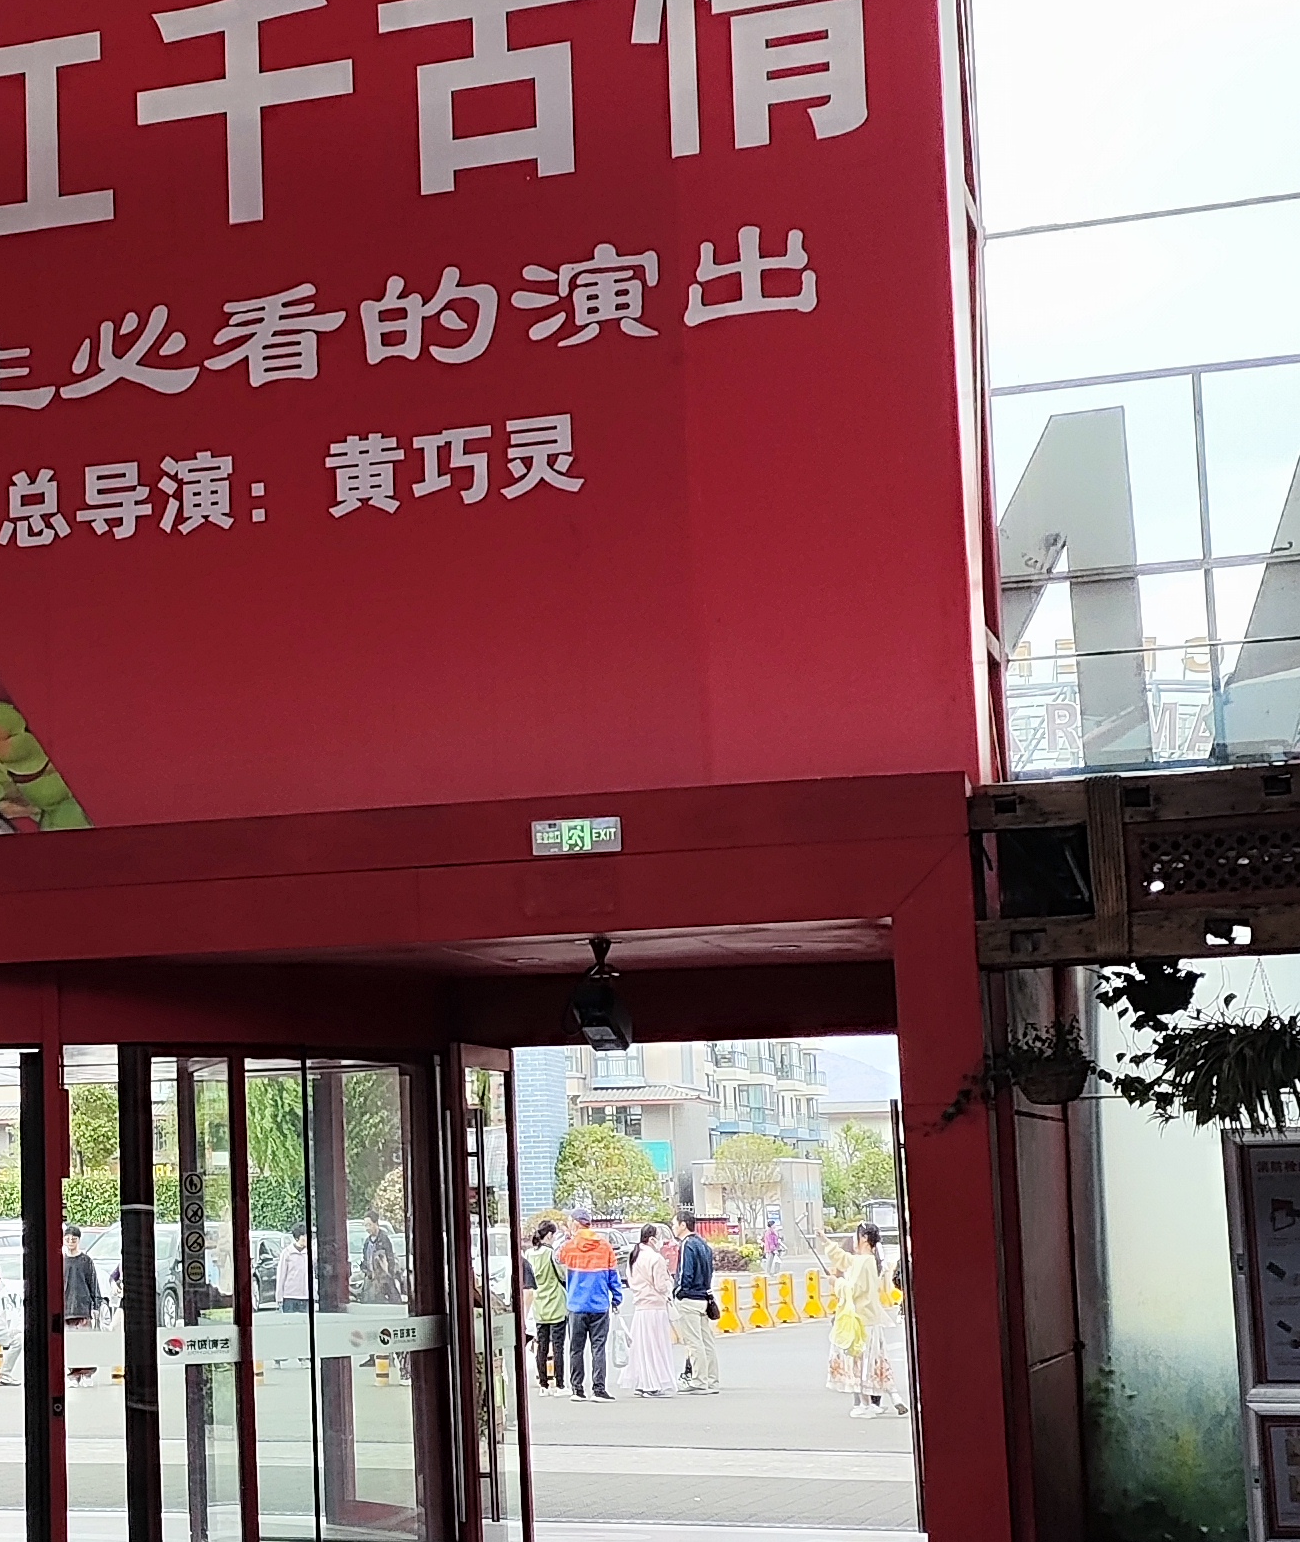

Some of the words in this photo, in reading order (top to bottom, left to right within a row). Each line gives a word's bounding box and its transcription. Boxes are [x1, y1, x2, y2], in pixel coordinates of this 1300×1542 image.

[325, 410, 586, 519] 黄巧灵
[592, 828, 617, 841] EXIT
